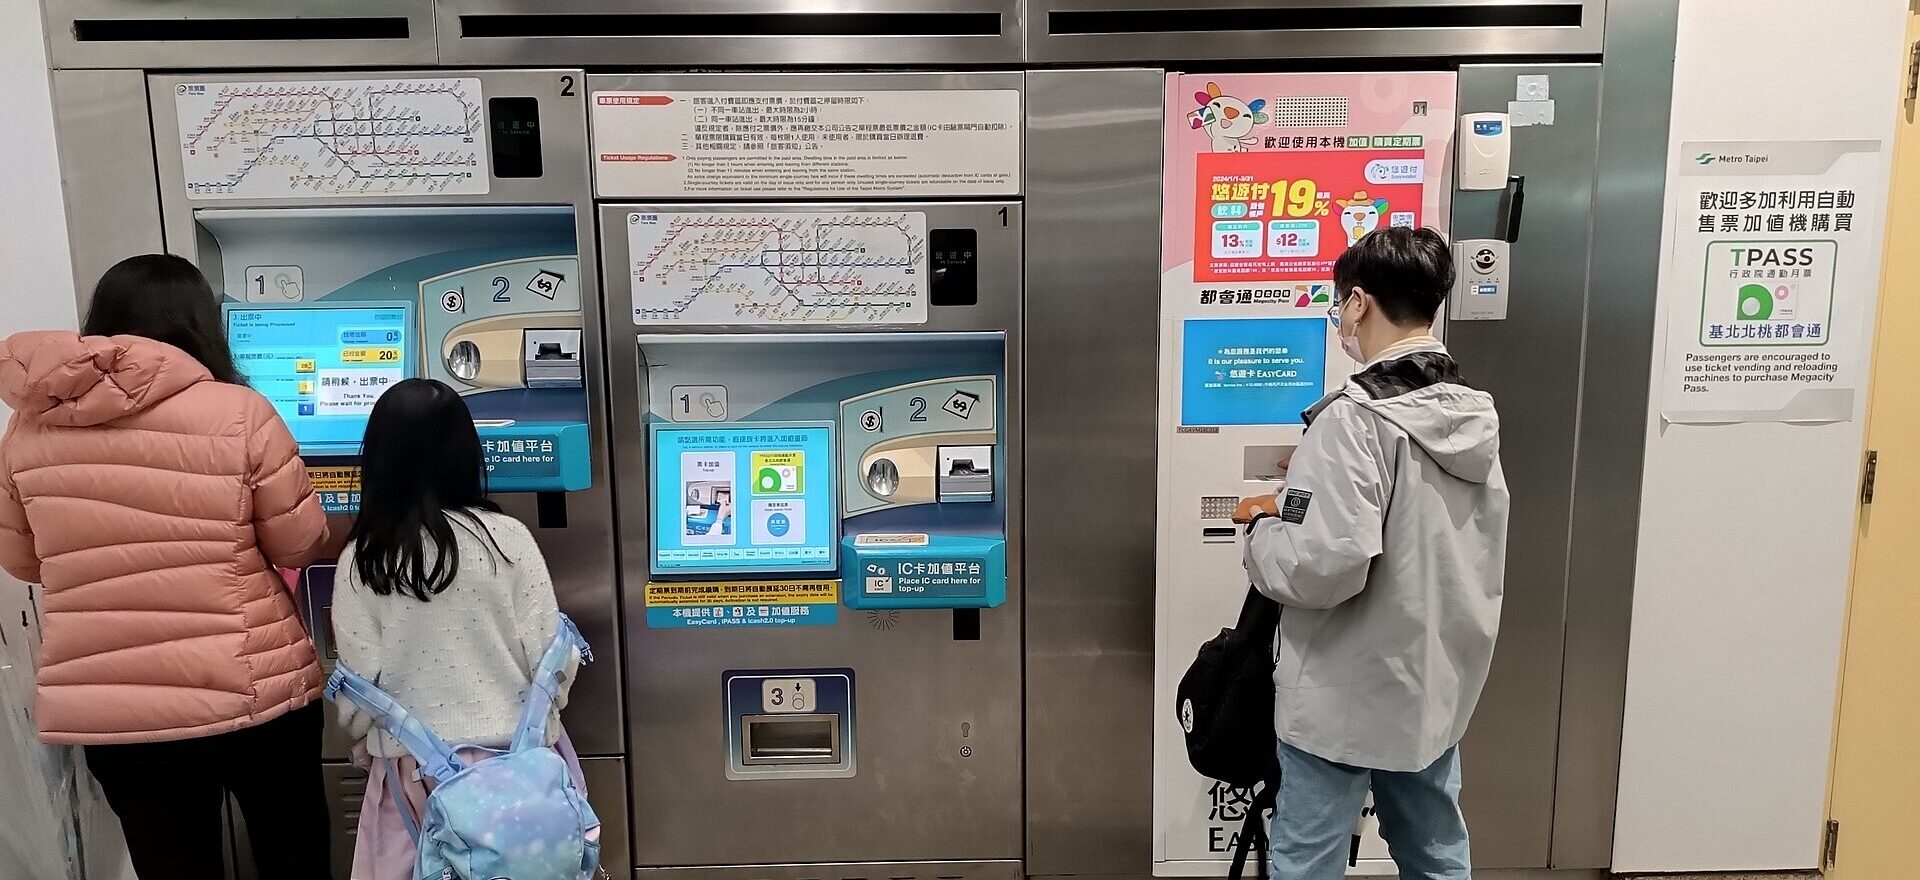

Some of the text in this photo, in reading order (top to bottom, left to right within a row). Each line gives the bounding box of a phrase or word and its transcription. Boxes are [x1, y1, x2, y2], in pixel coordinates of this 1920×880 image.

[559, 75, 575, 97] 2
[1413, 105, 1426, 114] 01
[1264, 136, 1345, 149] 歡迎使用本機
[1349, 137, 1368, 147] 加值
[1745, 154, 1769, 164] Taipei
[1211, 182, 1270, 201] 悠遊付
[1700, 190, 1855, 210] 歡迎多加利用自動
[998, 207, 1007, 226] 1
[1698, 213, 1853, 233] 售票加值機購買
[1276, 233, 1298, 247] $12
[1730, 248, 1814, 266] TPASS
[1729, 269, 1812, 278] 行政院通勤月票
[255, 275, 264, 295] 1
[492, 277, 511, 302] 2
[1201, 289, 1252, 304] 都會通
[386, 332, 393, 342] 0
[1709, 323, 1821, 339] 基北北桃都會通
[379, 351, 392, 360] 20
[1686, 354, 1741, 364] Passengers
[1762, 353, 1818, 363] encouraged
[1230, 369, 1255, 378] 悠遊卡
[1705, 364, 1730, 372] ticket
[1733, 363, 1770, 374] vending
[1773, 363, 1791, 371] and
[1794, 363, 1838, 373] reloading
[1684, 373, 1730, 382] machines
[1744, 373, 1788, 383] purchase
[1791, 373, 1834, 383] Megacity
[1683, 384, 1709, 392] Pass.
[680, 395, 690, 414] 1
[909, 397, 928, 422] 2
[482, 440, 553, 453] 卡加值平台
[898, 562, 981, 575] IC卡加值平台
[672, 606, 809, 617] 本機提供 及 加值服務
[771, 688, 784, 705] 3
